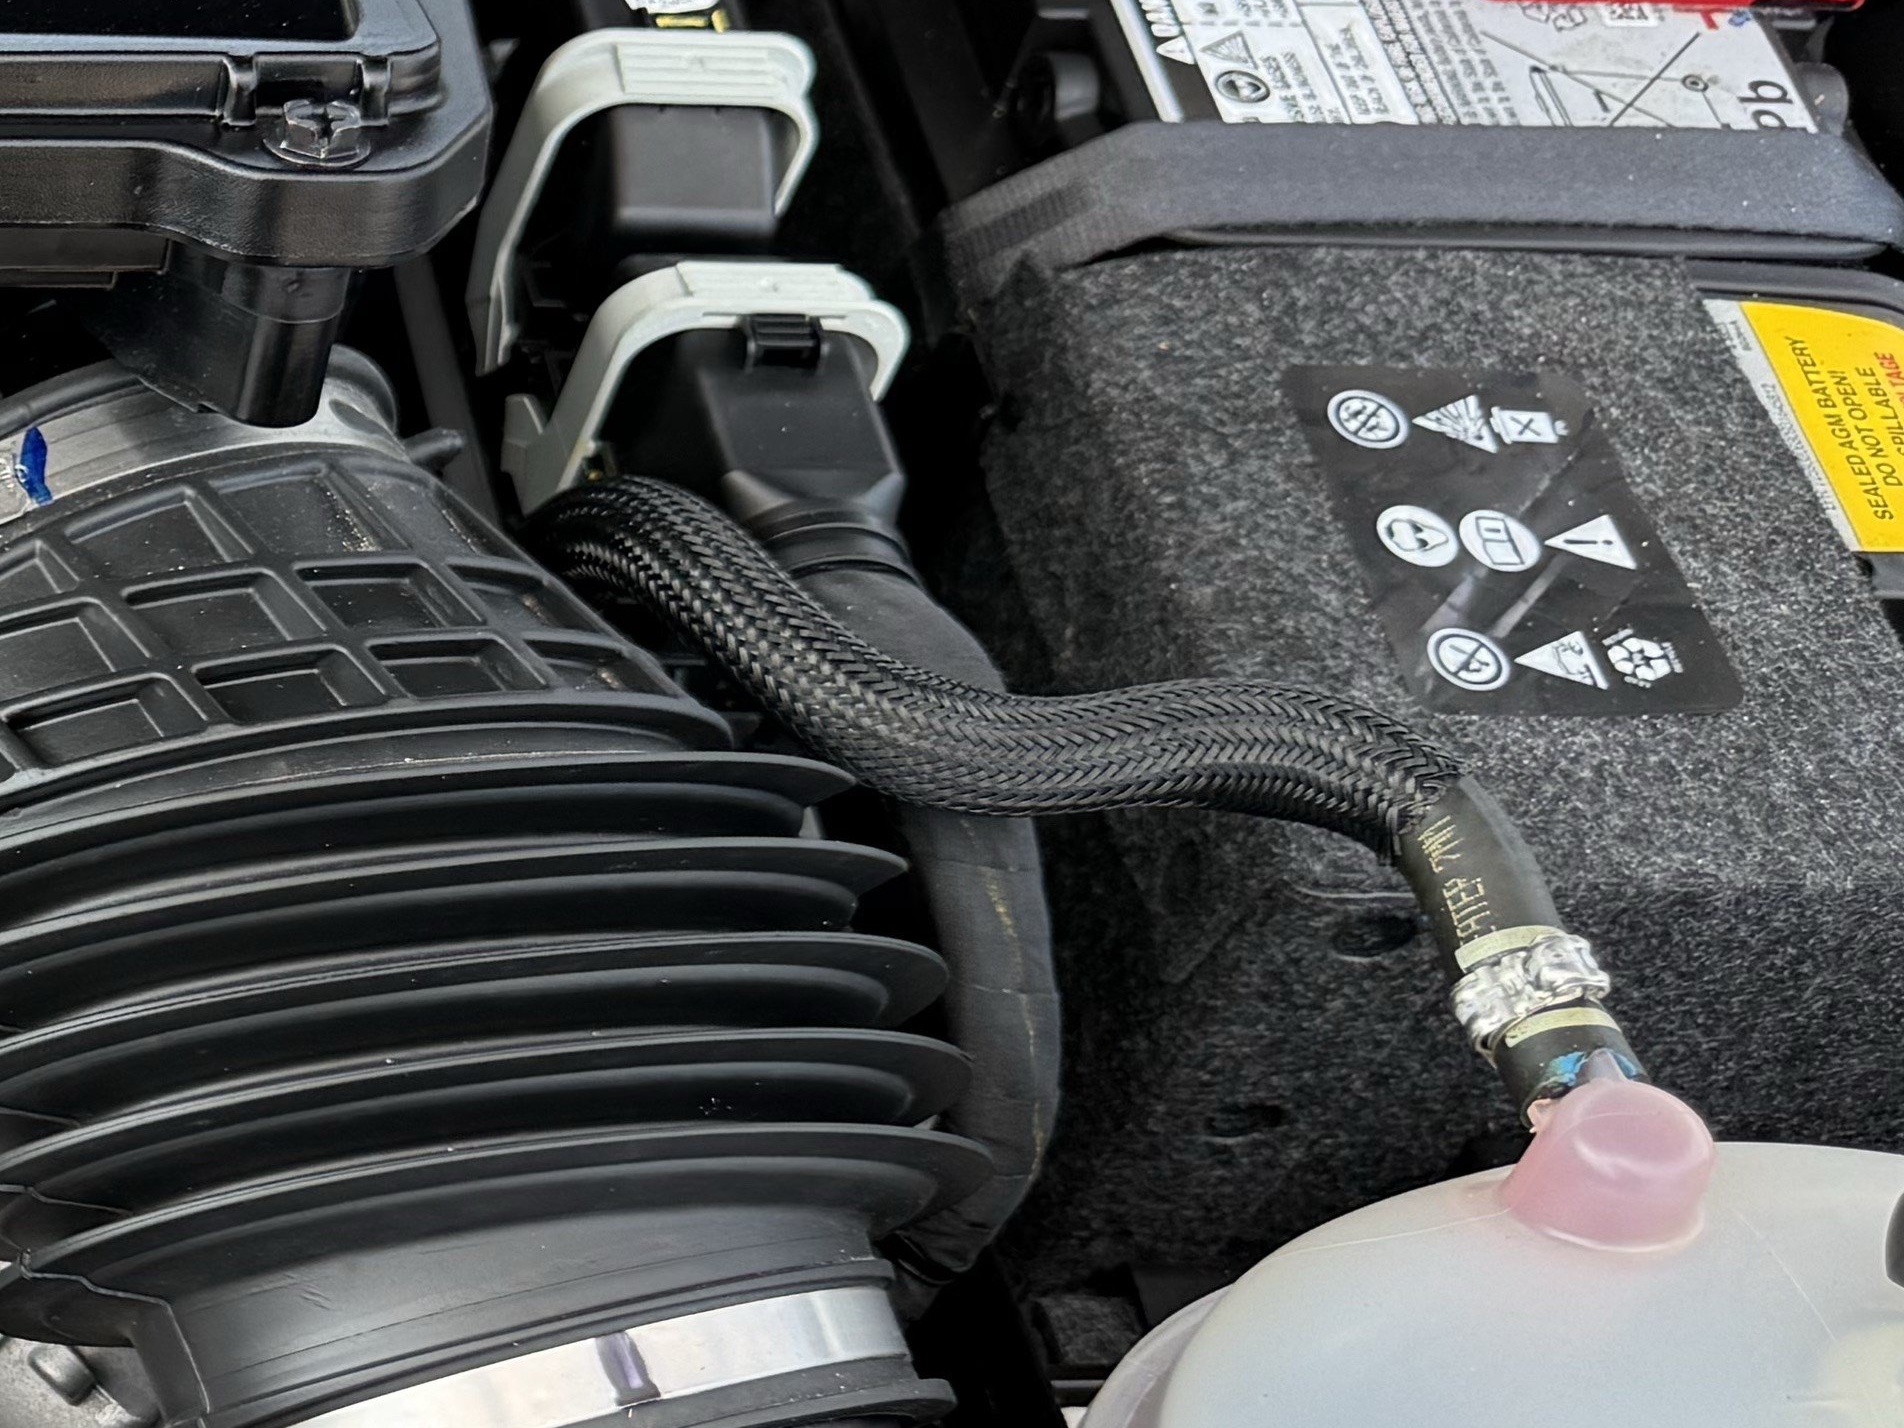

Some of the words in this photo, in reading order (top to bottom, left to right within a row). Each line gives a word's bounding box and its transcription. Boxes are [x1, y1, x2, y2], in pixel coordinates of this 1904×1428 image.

[1785, 336, 1837, 409] BATTERY
[1828, 370, 1868, 421] OPEN!
[1823, 414, 1860, 451] AGM
[1855, 425, 1889, 457] NOT
[1847, 454, 1894, 520] SEALED
[1876, 463, 1903, 486] DO
